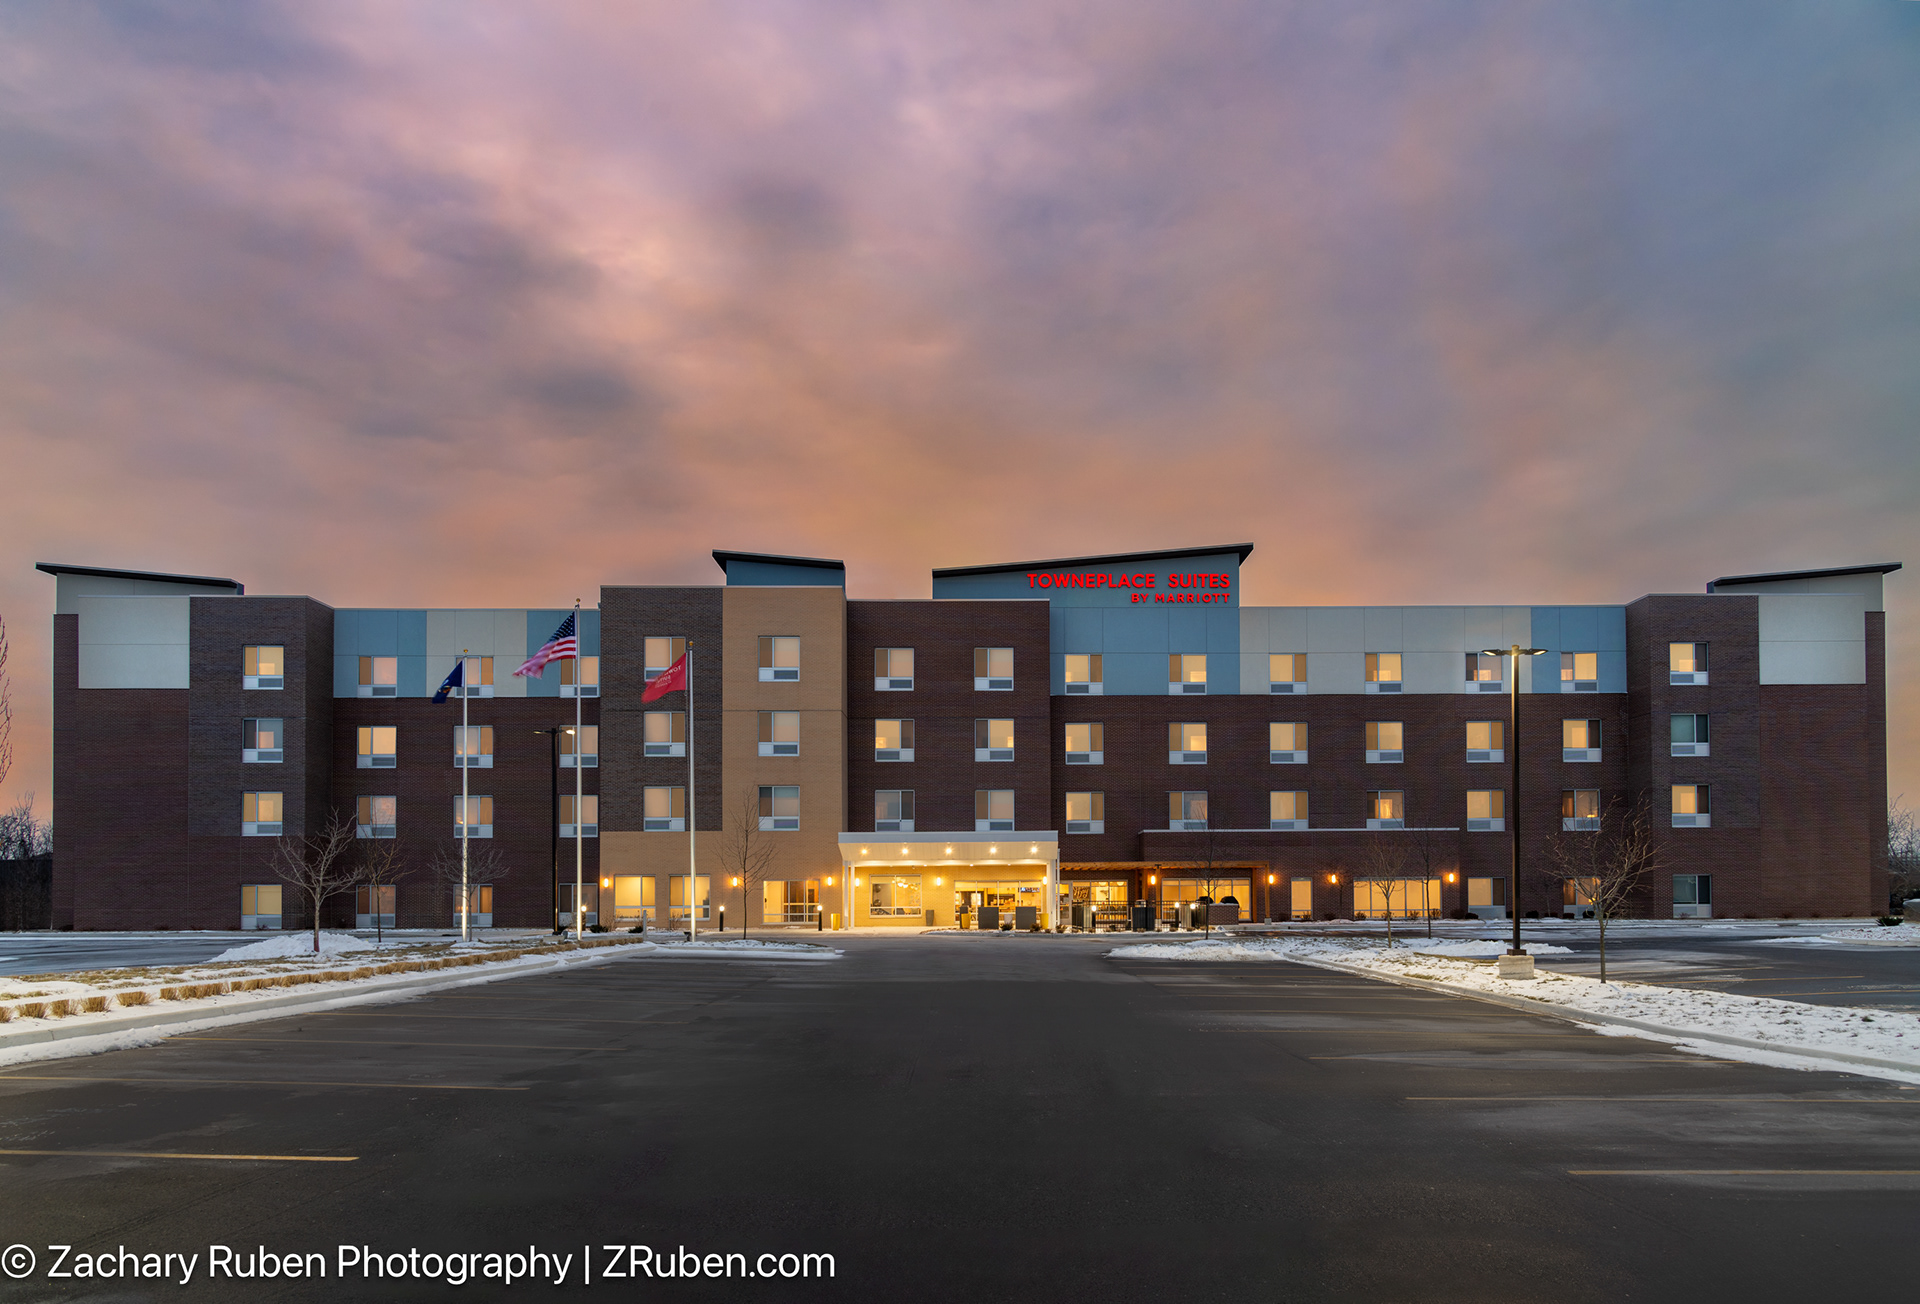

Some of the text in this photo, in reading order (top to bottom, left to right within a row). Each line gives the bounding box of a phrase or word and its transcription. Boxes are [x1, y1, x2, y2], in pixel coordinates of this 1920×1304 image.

[1026, 573, 1231, 589] TOWNEPLACE SUITES
[1131, 593, 1231, 603] BY MARRIOTT
